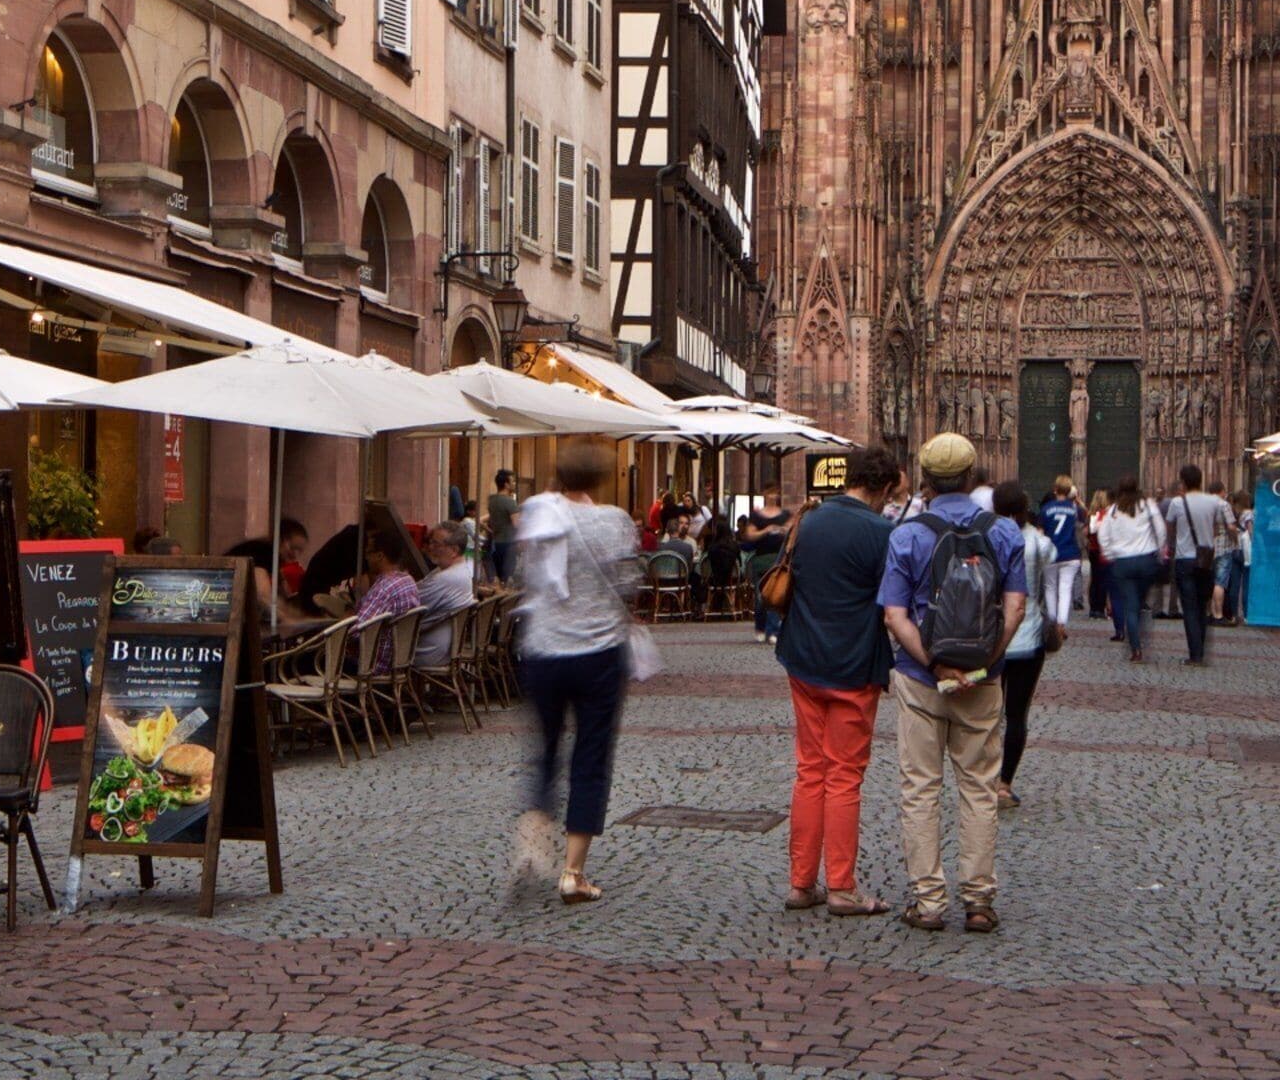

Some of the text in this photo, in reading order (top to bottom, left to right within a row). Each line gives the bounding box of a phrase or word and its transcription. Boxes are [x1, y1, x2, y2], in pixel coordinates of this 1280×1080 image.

[1054, 514, 1067, 535] 7
[27, 563, 77, 583] VENEZ
[111, 640, 223, 662] BURGERS
